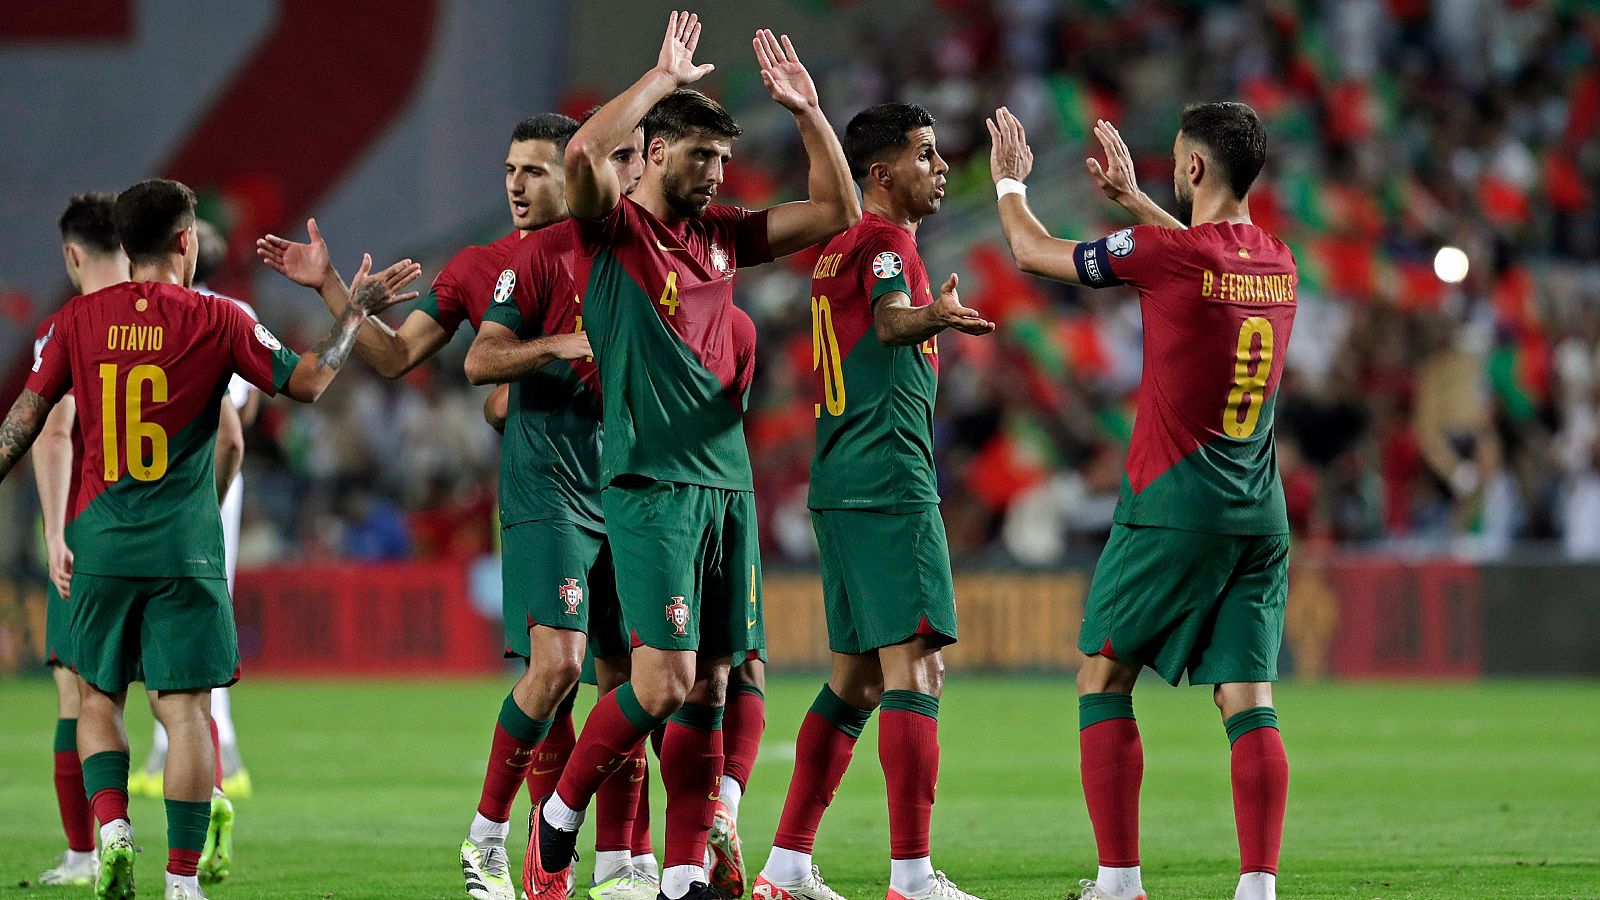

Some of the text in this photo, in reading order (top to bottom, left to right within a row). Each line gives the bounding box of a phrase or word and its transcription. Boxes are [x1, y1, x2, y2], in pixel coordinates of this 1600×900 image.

[660, 271, 679, 316] 4
[107, 323, 164, 351] OTÁVIO
[1223, 316, 1274, 439] 8
[99, 363, 168, 483] 16
[750, 564, 757, 611] 4
